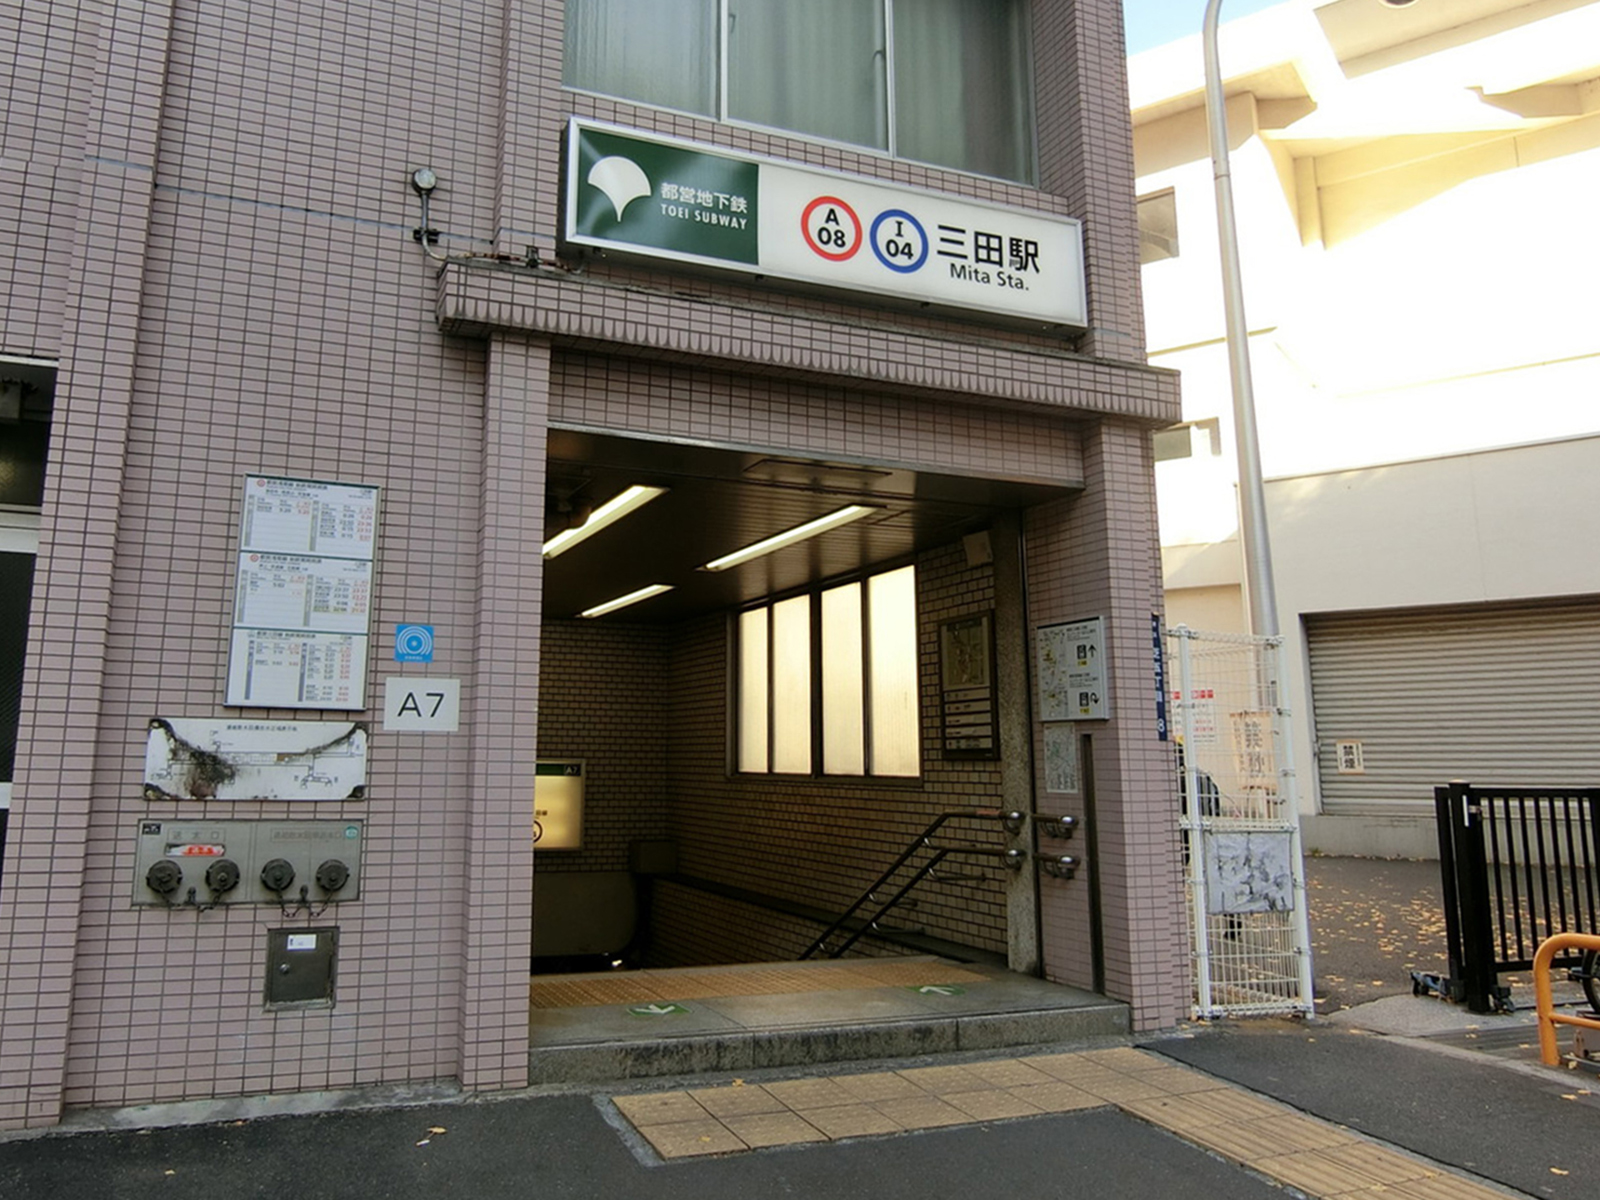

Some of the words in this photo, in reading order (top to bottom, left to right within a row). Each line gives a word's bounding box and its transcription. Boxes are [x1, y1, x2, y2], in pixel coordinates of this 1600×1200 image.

[661, 183, 747, 213] 都営地下鉄
[661, 204, 689, 219] TOEI
[694, 210, 747, 230] SUBWAY
[825, 208, 840, 226] A
[817, 227, 846, 248] 08
[895, 220, 904, 238] I
[885, 239, 914, 260] 04
[937, 224, 1040, 274] 三田駅
[950, 263, 991, 284] Mita
[996, 271, 1029, 291] Sta.
[397, 691, 445, 718] A7
[565, 766, 578, 774] A7
